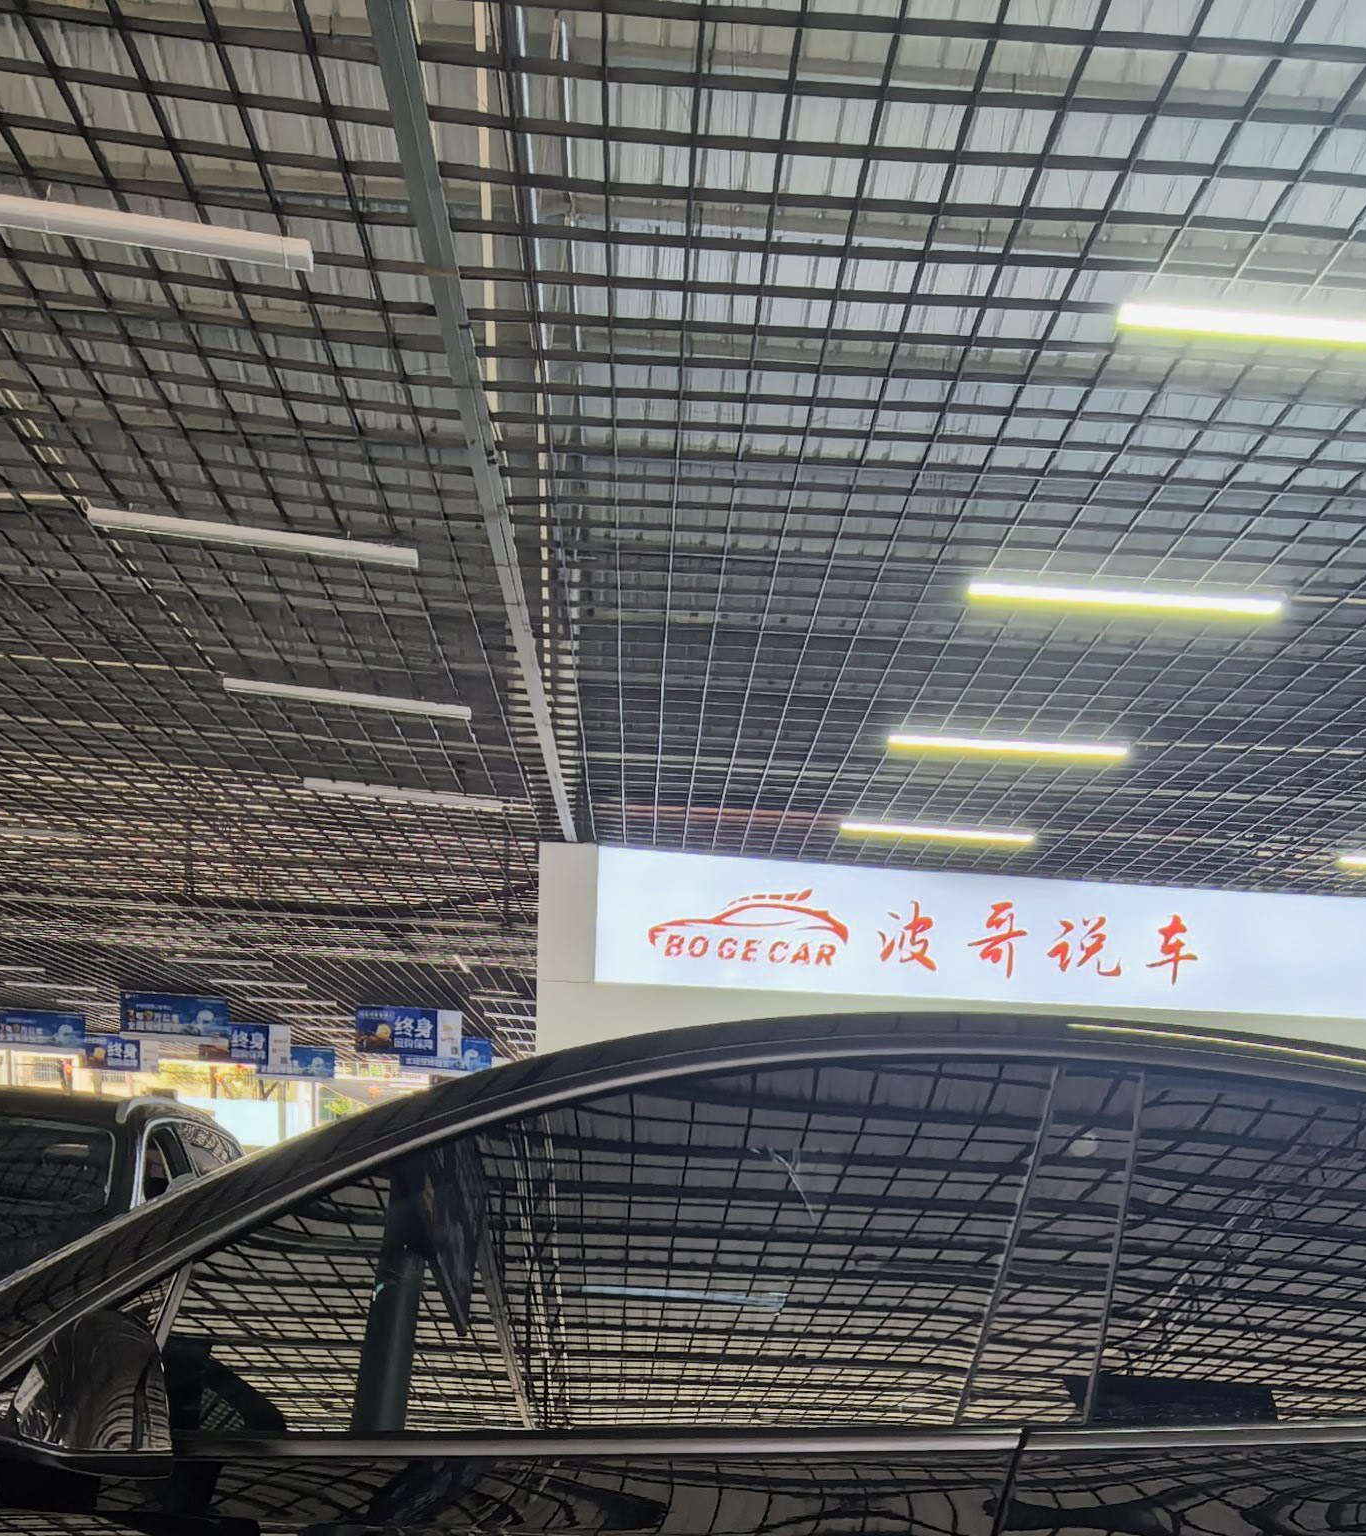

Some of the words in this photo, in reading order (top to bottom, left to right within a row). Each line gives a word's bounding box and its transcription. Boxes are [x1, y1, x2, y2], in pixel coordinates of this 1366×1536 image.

[876, 901, 1199, 986] 波哥说车
[394, 1016, 435, 1039] 终身
[107, 1042, 139, 1059] 终身
[231, 1030, 267, 1050] 终身
